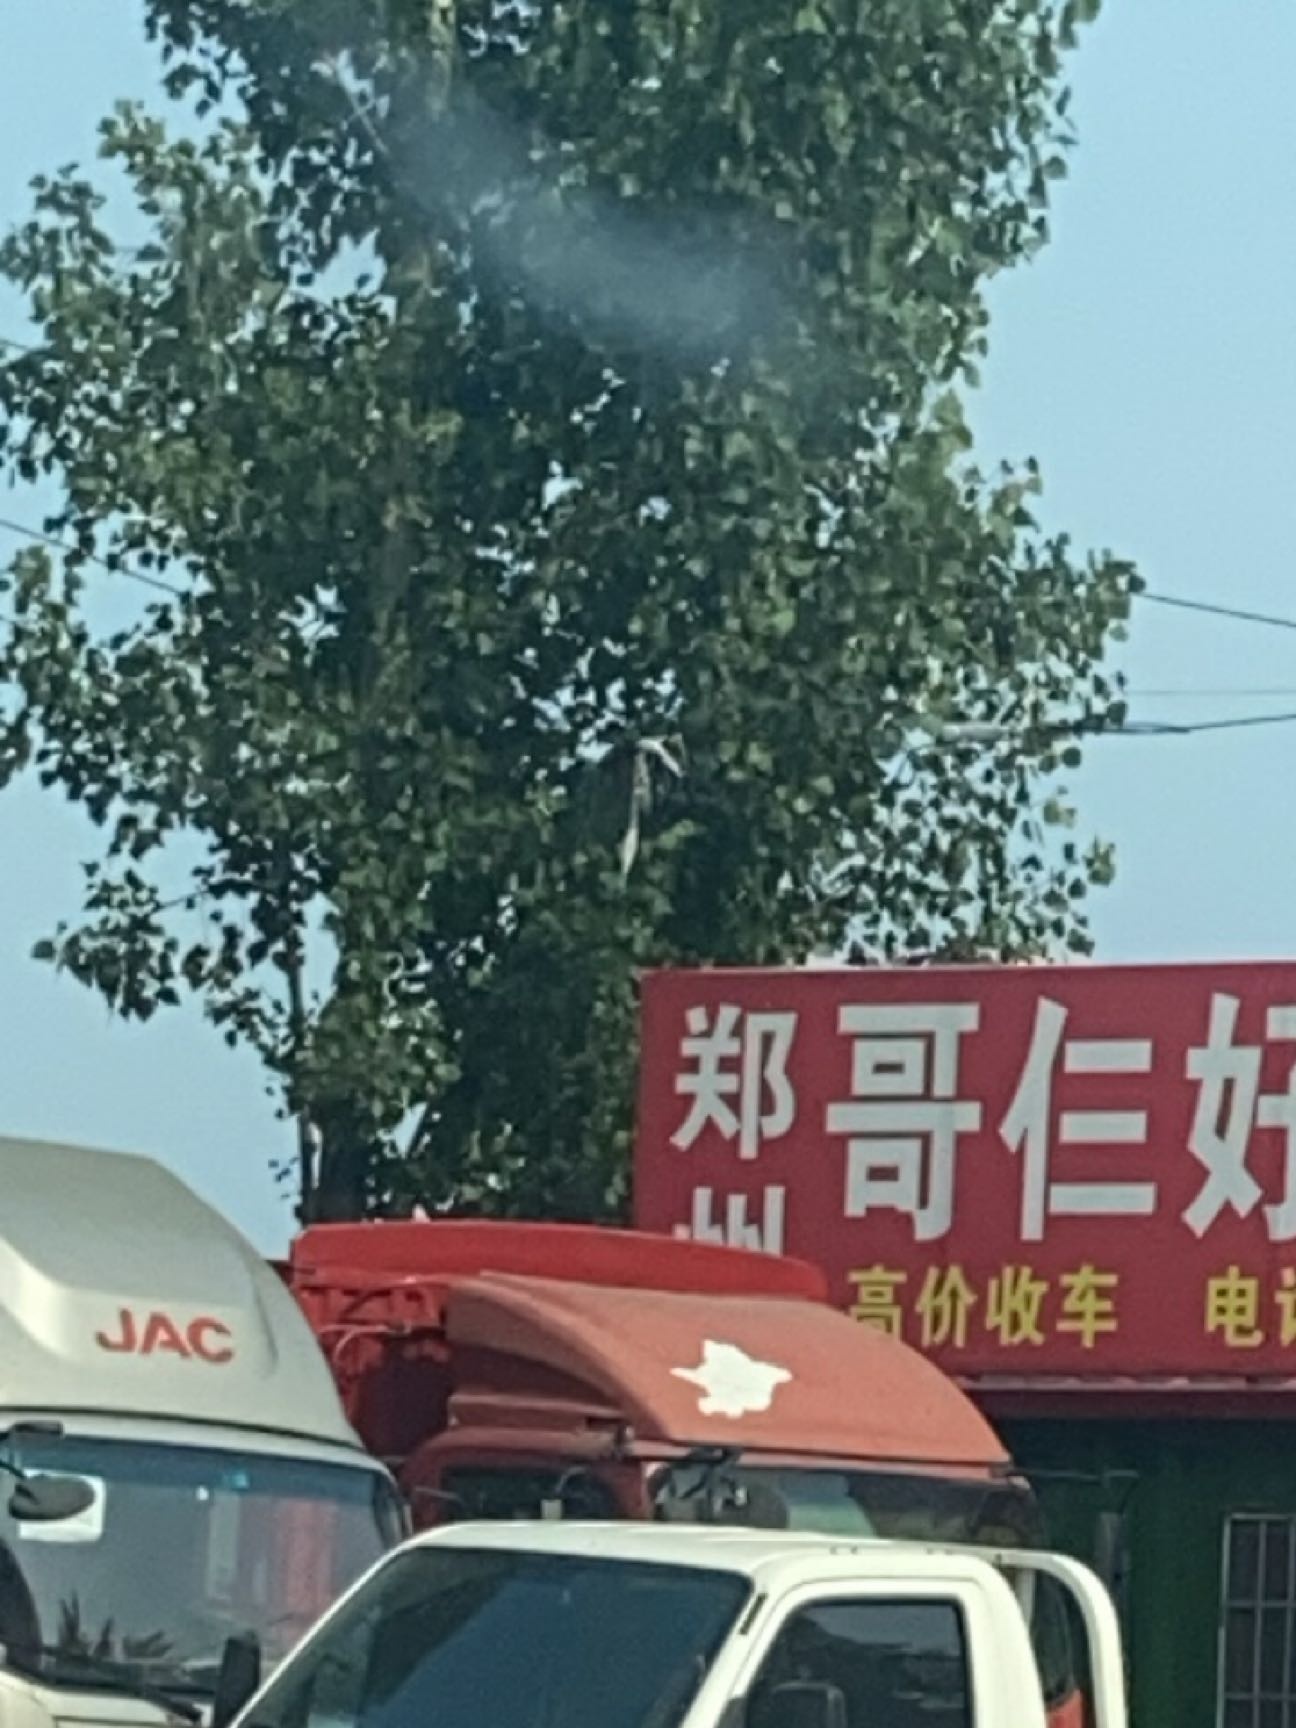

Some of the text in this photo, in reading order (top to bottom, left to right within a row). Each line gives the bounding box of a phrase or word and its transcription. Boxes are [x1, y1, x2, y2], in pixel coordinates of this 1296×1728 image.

[95, 1308, 235, 1364] JAC
[846, 1264, 1119, 1348] 高价收车
